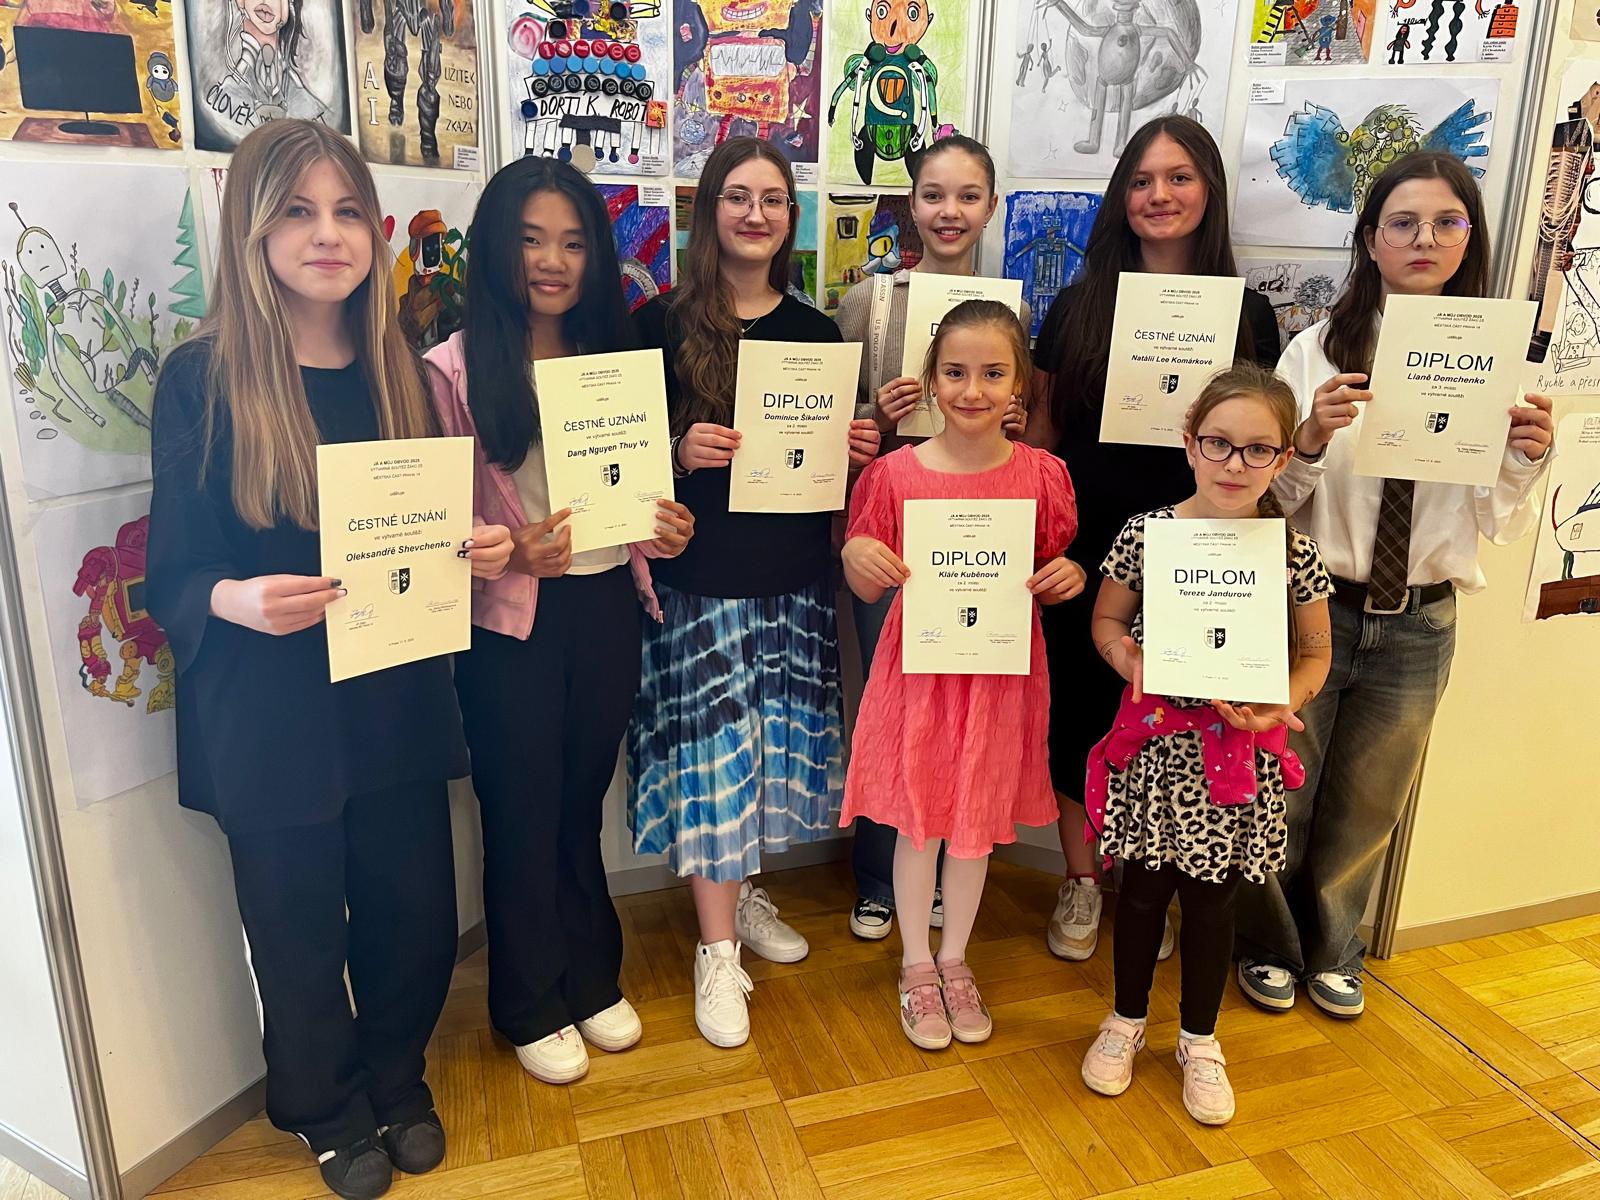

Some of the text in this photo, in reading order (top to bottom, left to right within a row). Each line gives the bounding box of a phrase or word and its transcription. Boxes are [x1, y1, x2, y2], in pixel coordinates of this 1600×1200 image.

[444, 63, 476, 85] UŽITEK
[206, 82, 256, 128] ČLOVĚK
[448, 94, 473, 110] NEBO
[610, 99, 647, 121] ROBOT
[1134, 329, 1216, 343] ČESTNÉ UZNÁNÍ
[1171, 356, 1213, 366] Komárkové
[1406, 351, 1494, 371] DIPLOM
[1537, 375, 1564, 392] Rychle
[763, 393, 834, 409] DIPLOM
[563, 411, 647, 432] ČESTNÉ UZNÁNÍ
[764, 413, 830, 421] Dominice Šikalové
[567, 439, 649, 458] Dang Nguyen Thuy Vy
[348, 508, 447, 532] ČESTNÉ UZNÁNÍ
[398, 540, 451, 554] Shevchenko
[932, 551, 1006, 566] DIPLOM
[1174, 569, 1256, 585] DIPLOM
[1179, 589, 1252, 598] Tereze Jandurové
